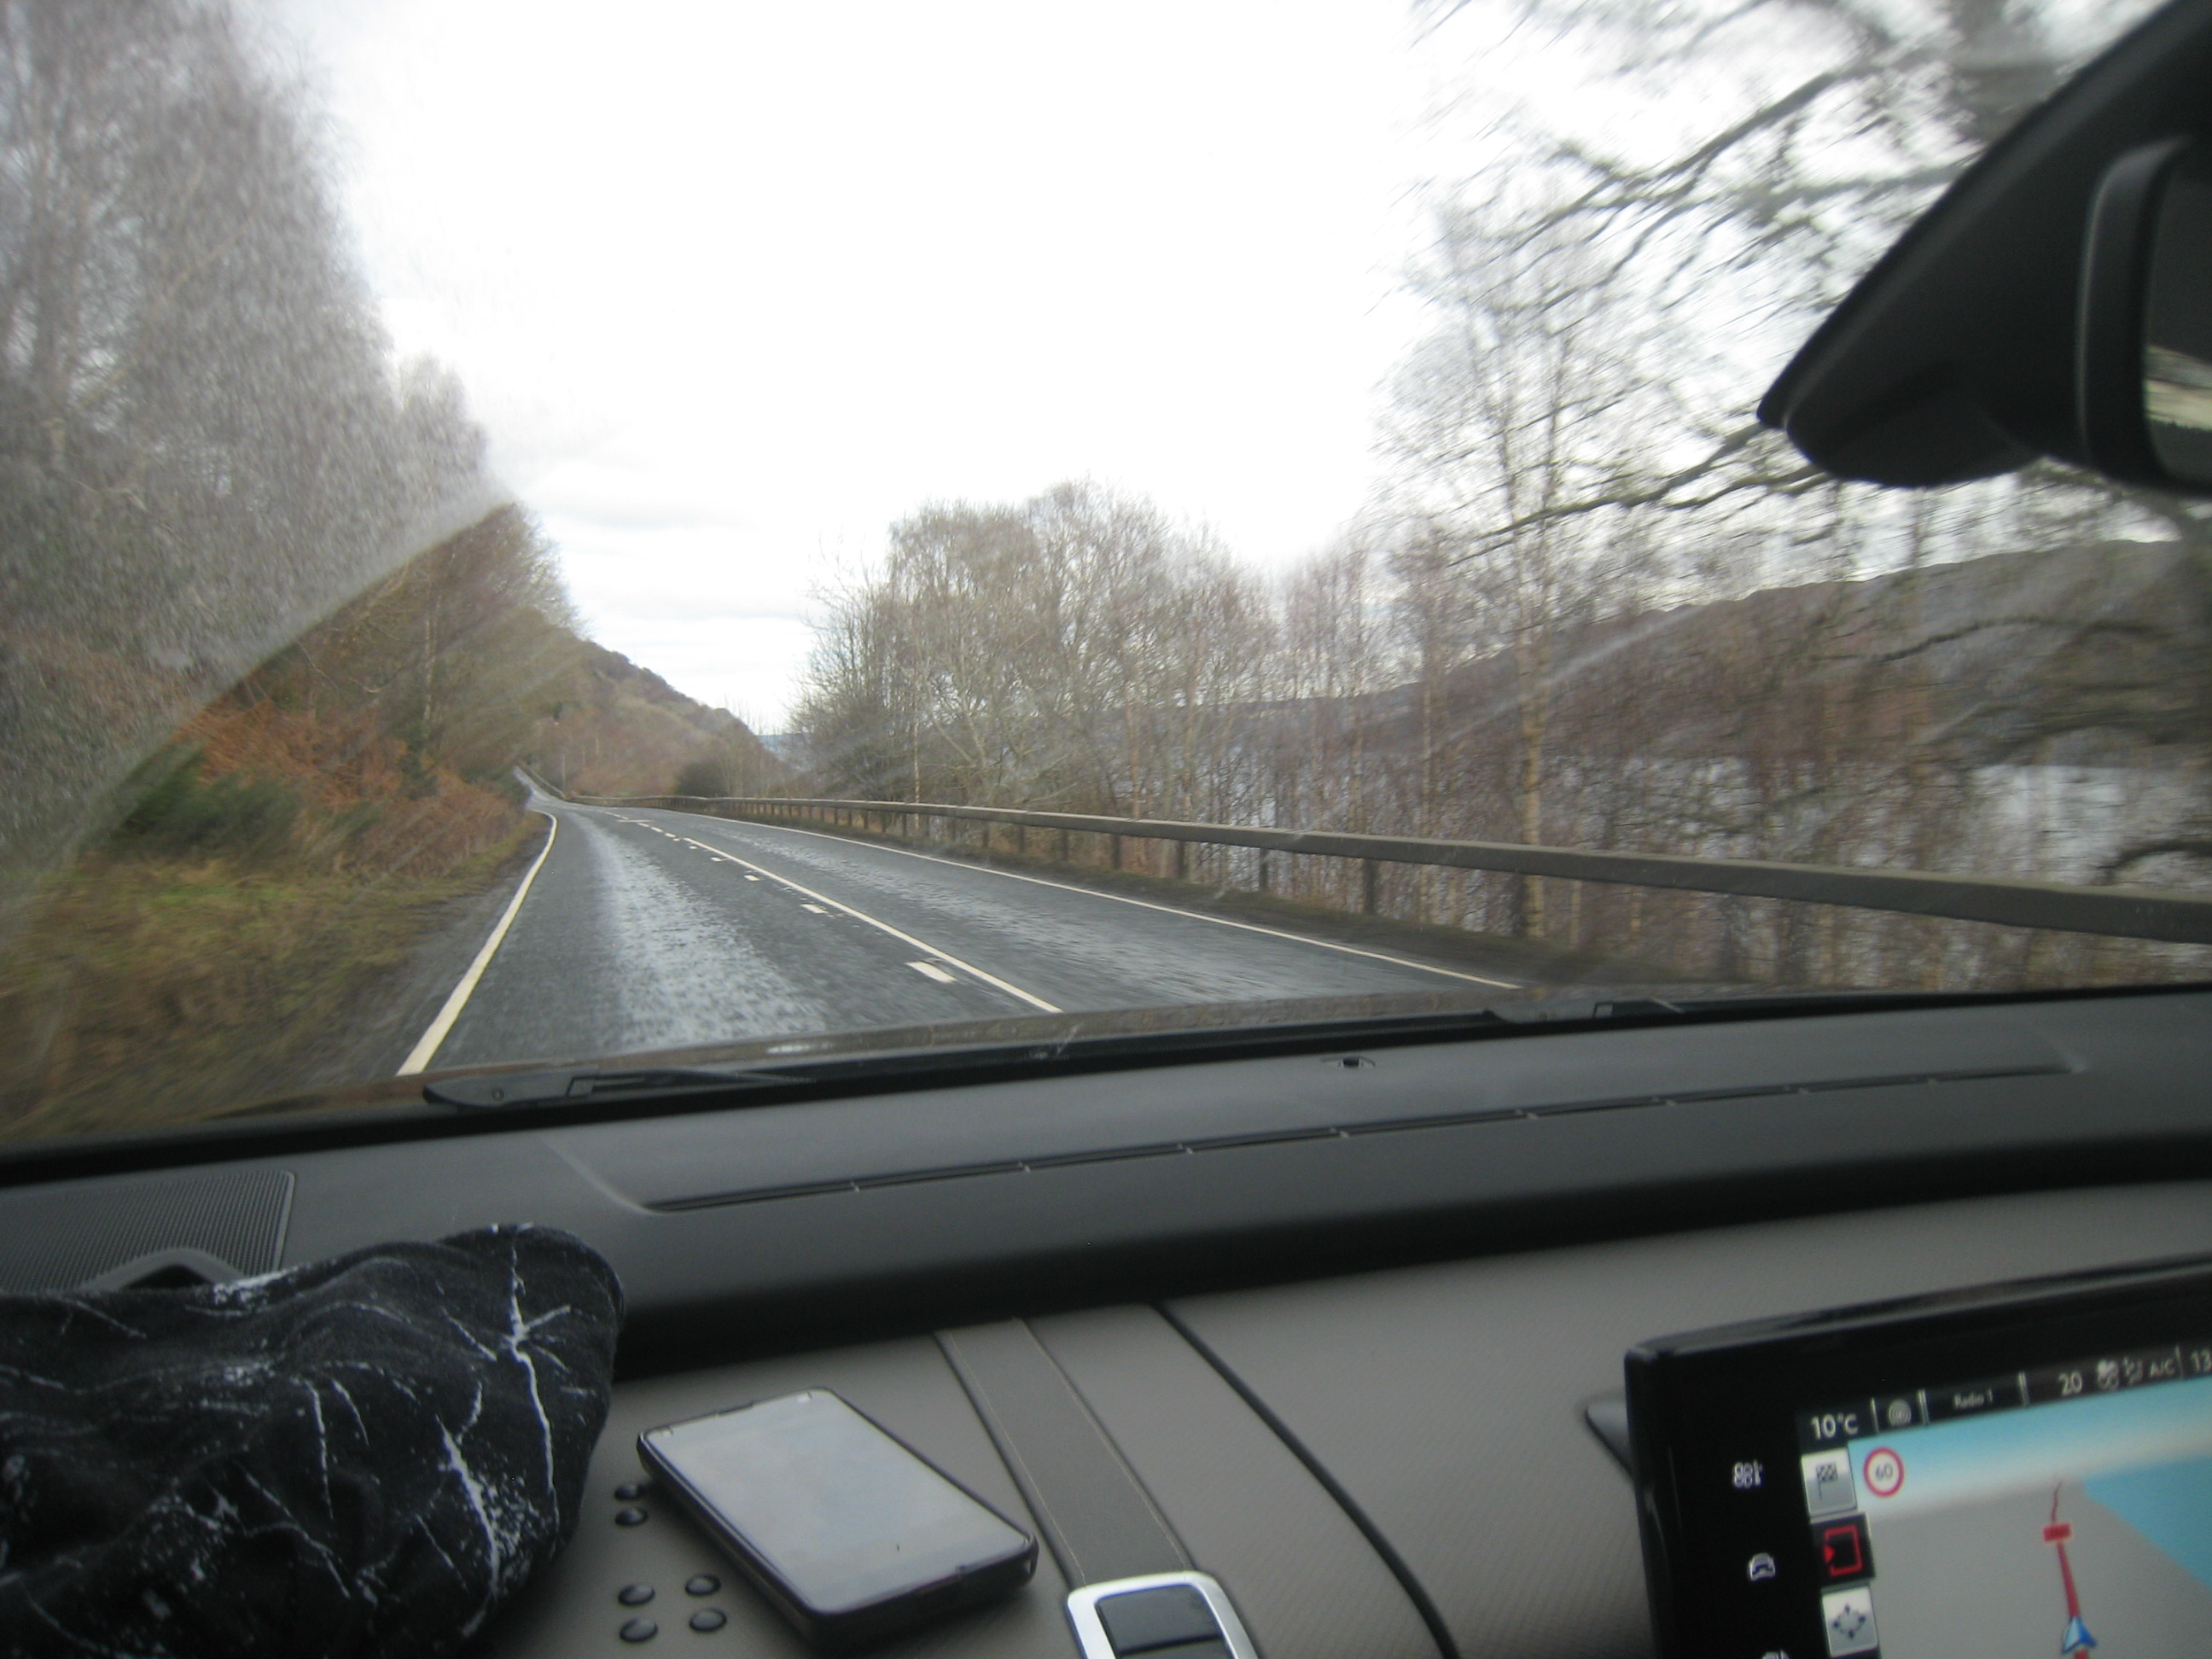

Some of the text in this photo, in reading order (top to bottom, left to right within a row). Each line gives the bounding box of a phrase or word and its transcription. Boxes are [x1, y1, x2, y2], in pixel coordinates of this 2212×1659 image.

[2058, 1371, 2083, 1396] 20
[1810, 1414, 1859, 1440] 10°C
[1875, 1464, 1894, 1481] 60
